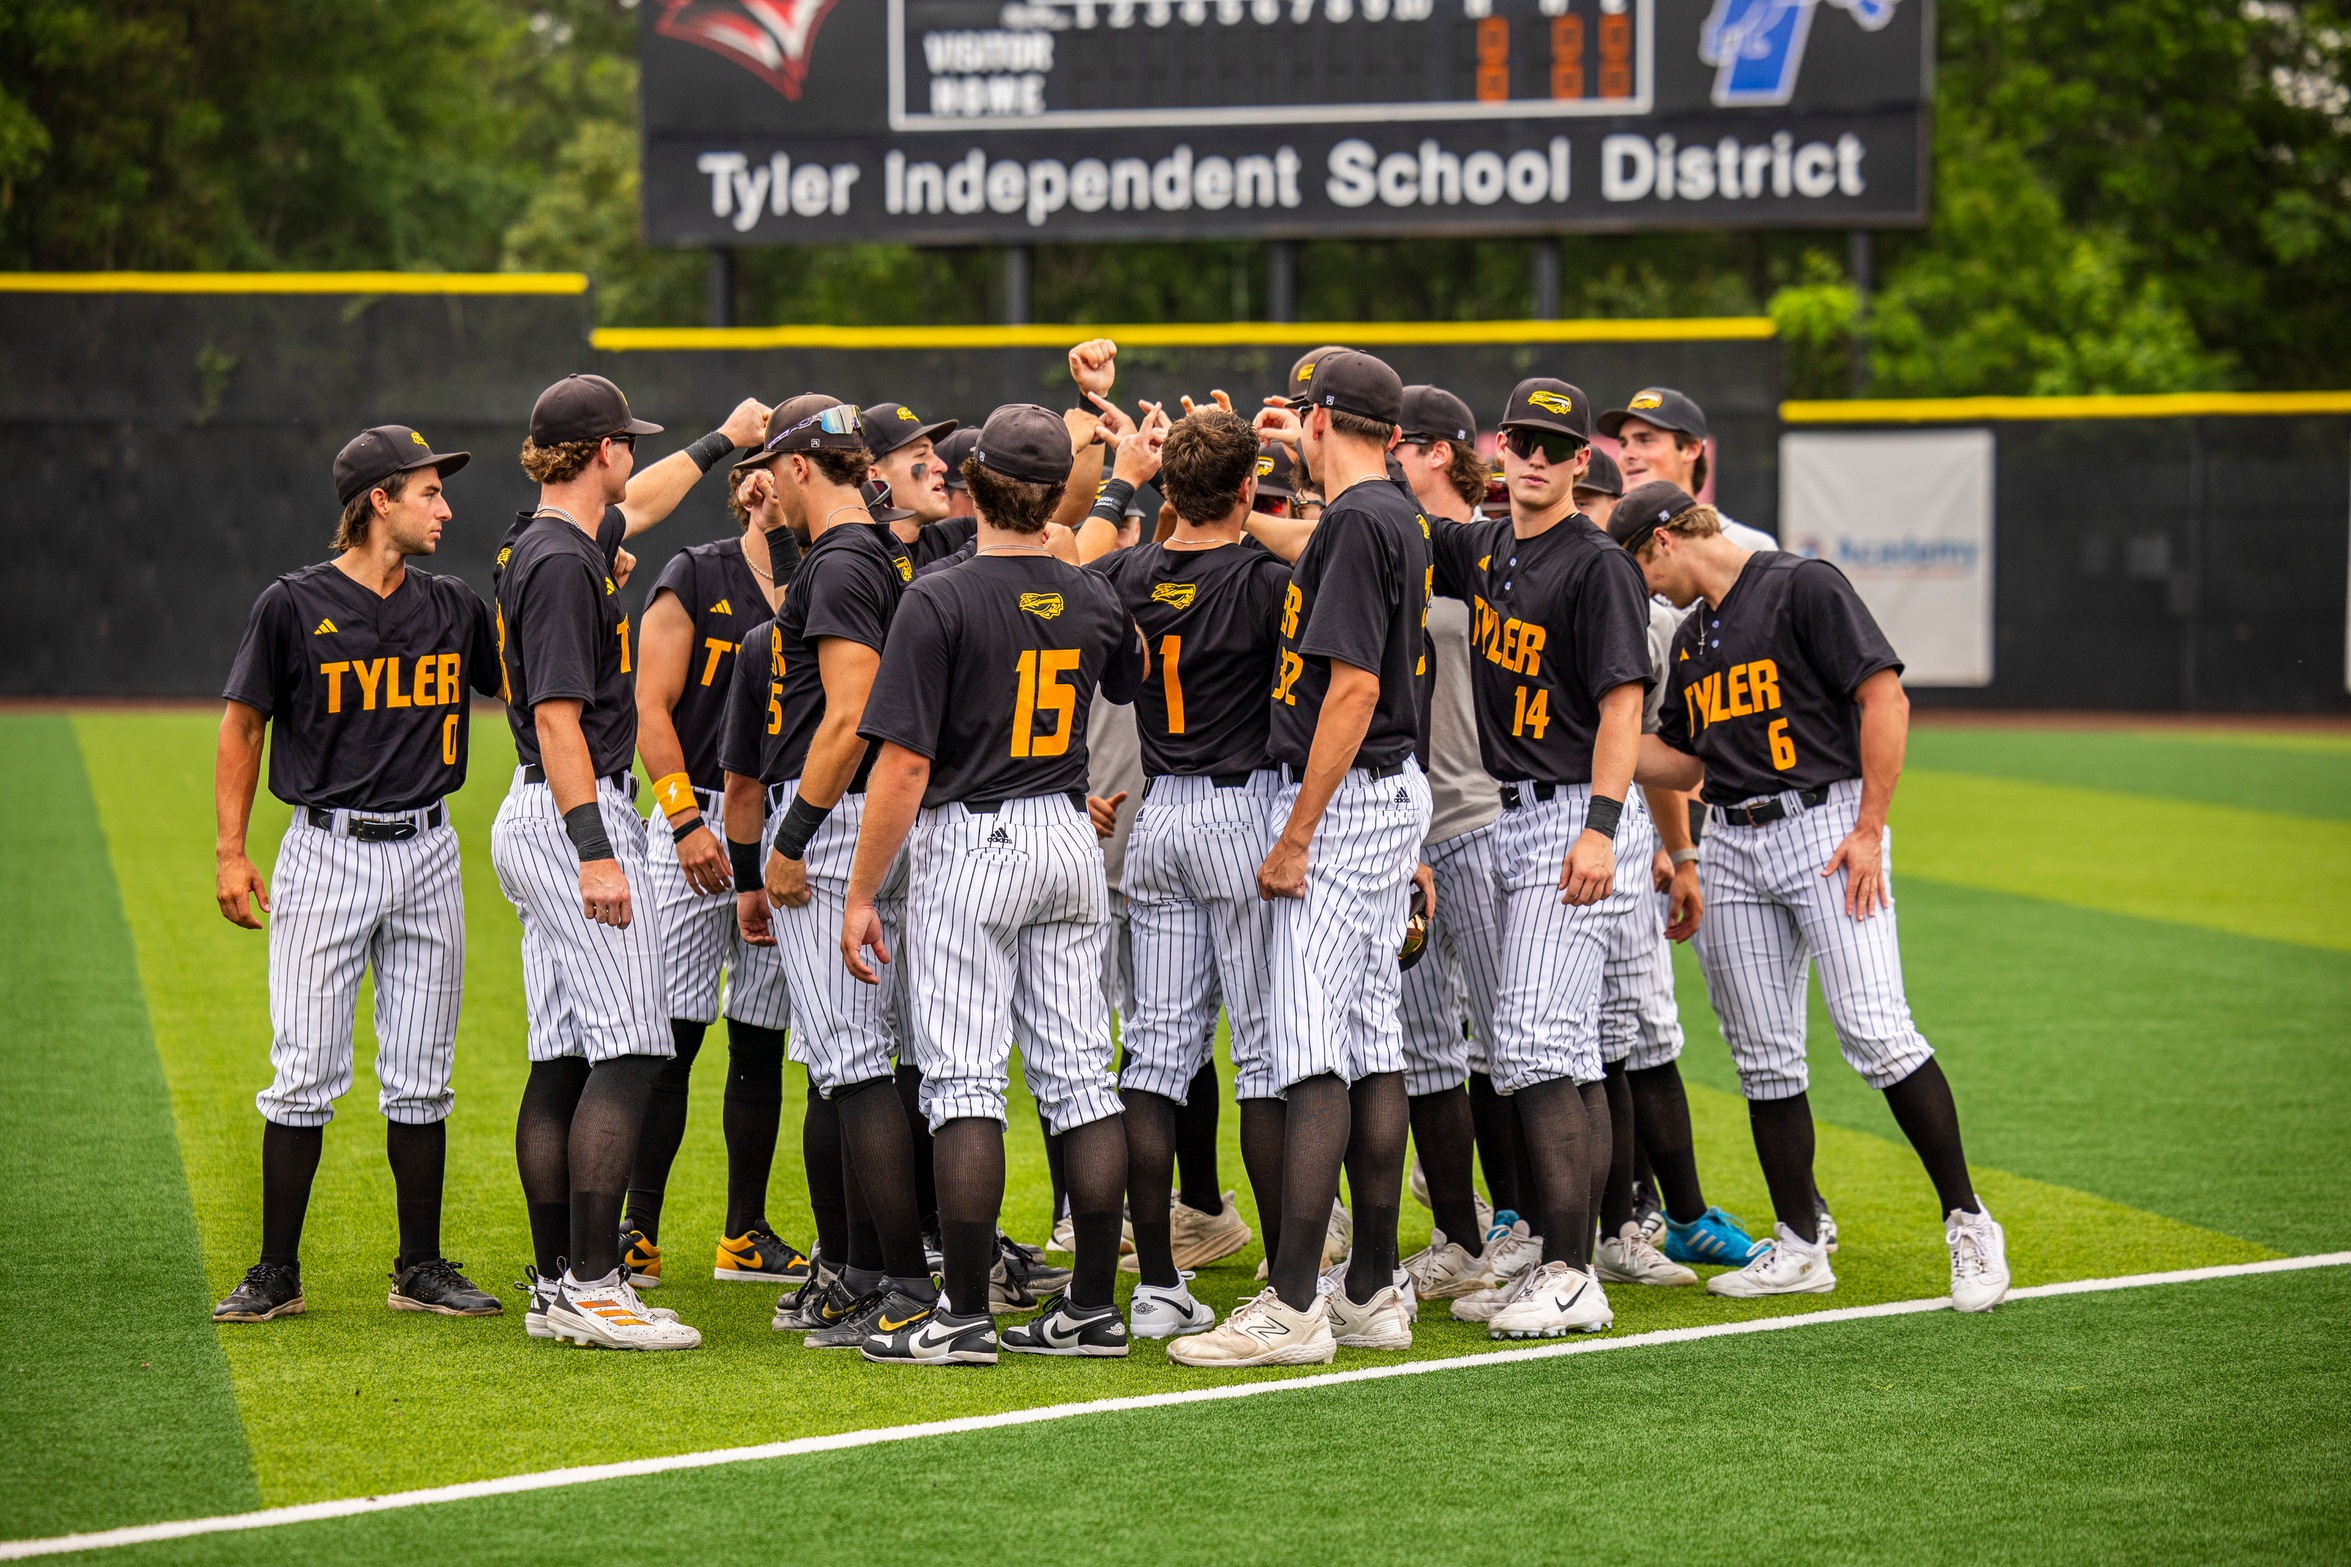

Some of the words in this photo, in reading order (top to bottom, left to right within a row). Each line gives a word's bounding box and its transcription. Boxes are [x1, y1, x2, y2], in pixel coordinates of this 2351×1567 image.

[923, 31, 1054, 73] VISITOR
[698, 152, 860, 232] Tyler
[885, 146, 1300, 226] Independent
[1326, 138, 1571, 207] School
[1601, 131, 1866, 201] District
[1472, 595, 1547, 677] TYLER
[320, 652, 461, 714] TYLER
[1010, 648, 1081, 758] 15
[1159, 634, 1185, 734] 1
[1511, 685, 1551, 740] 14
[1683, 658, 1784, 739] TYLER
[442, 714, 460, 765] 0
[1767, 717, 1797, 771] 6
